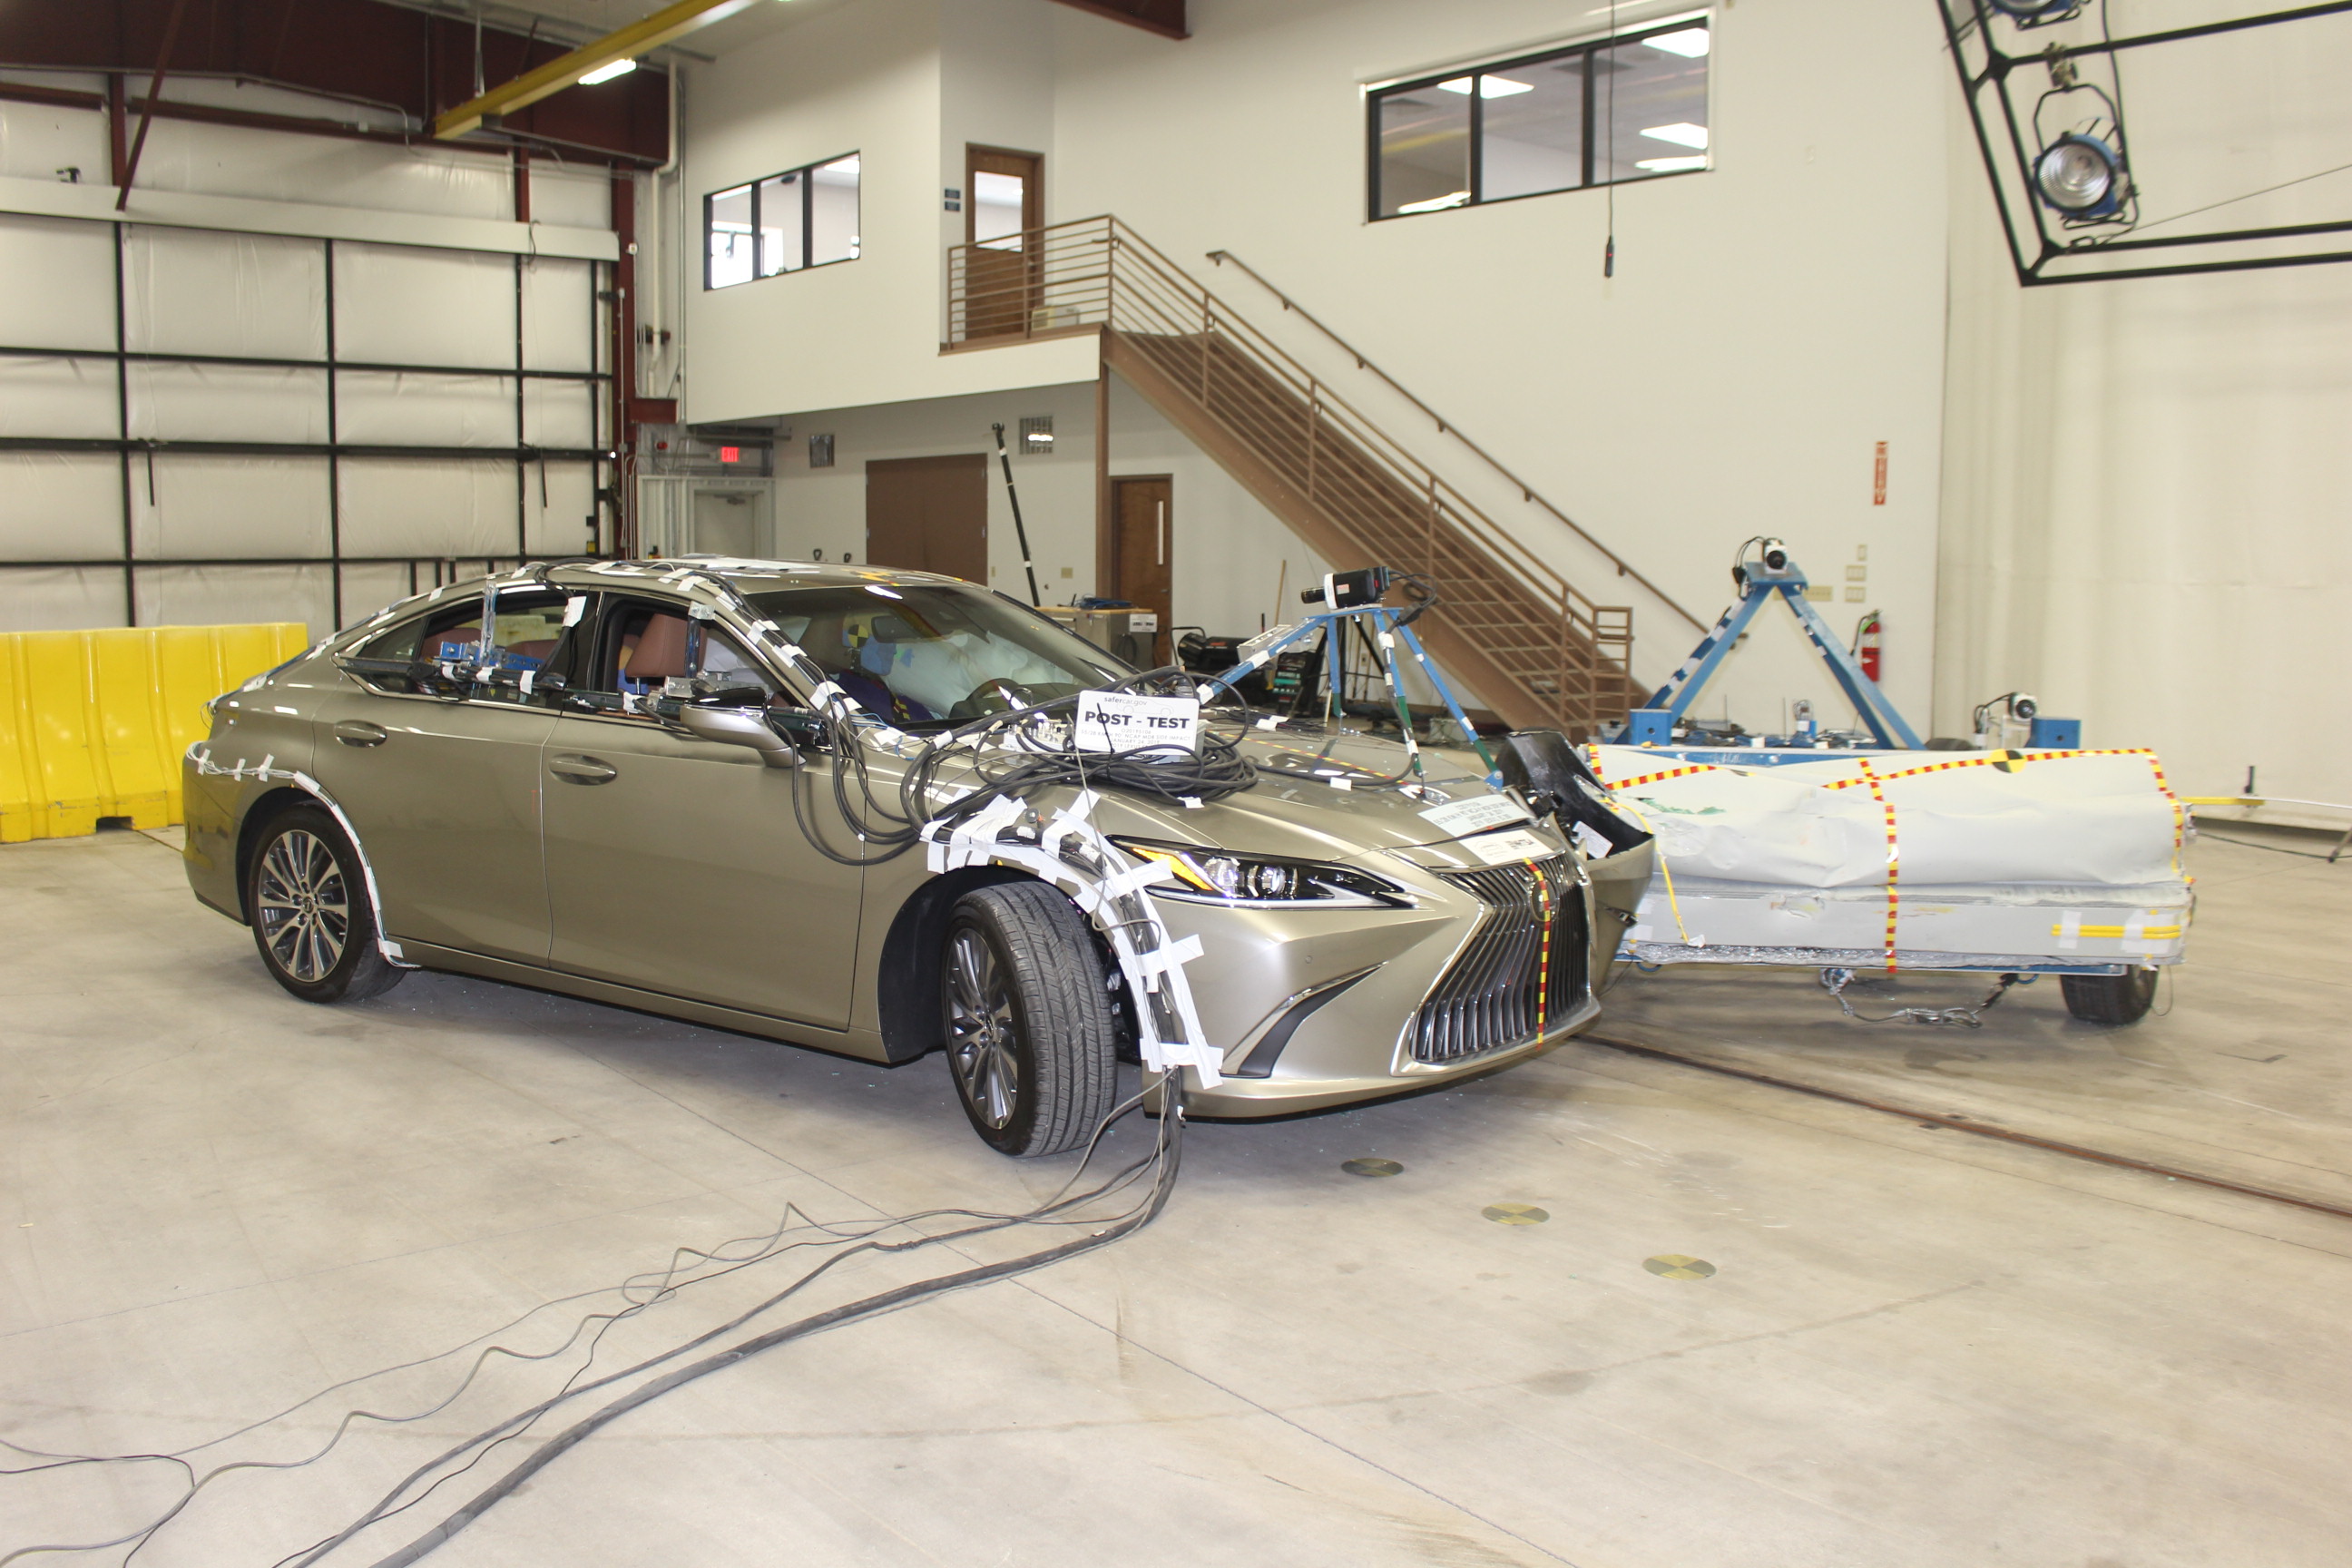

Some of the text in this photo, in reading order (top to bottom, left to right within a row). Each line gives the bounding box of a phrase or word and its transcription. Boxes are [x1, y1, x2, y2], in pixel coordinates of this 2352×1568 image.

[1103, 696, 1148, 707] safercar.gov
[1084, 710, 1132, 726] POST
[1147, 717, 1190, 729] TEST
